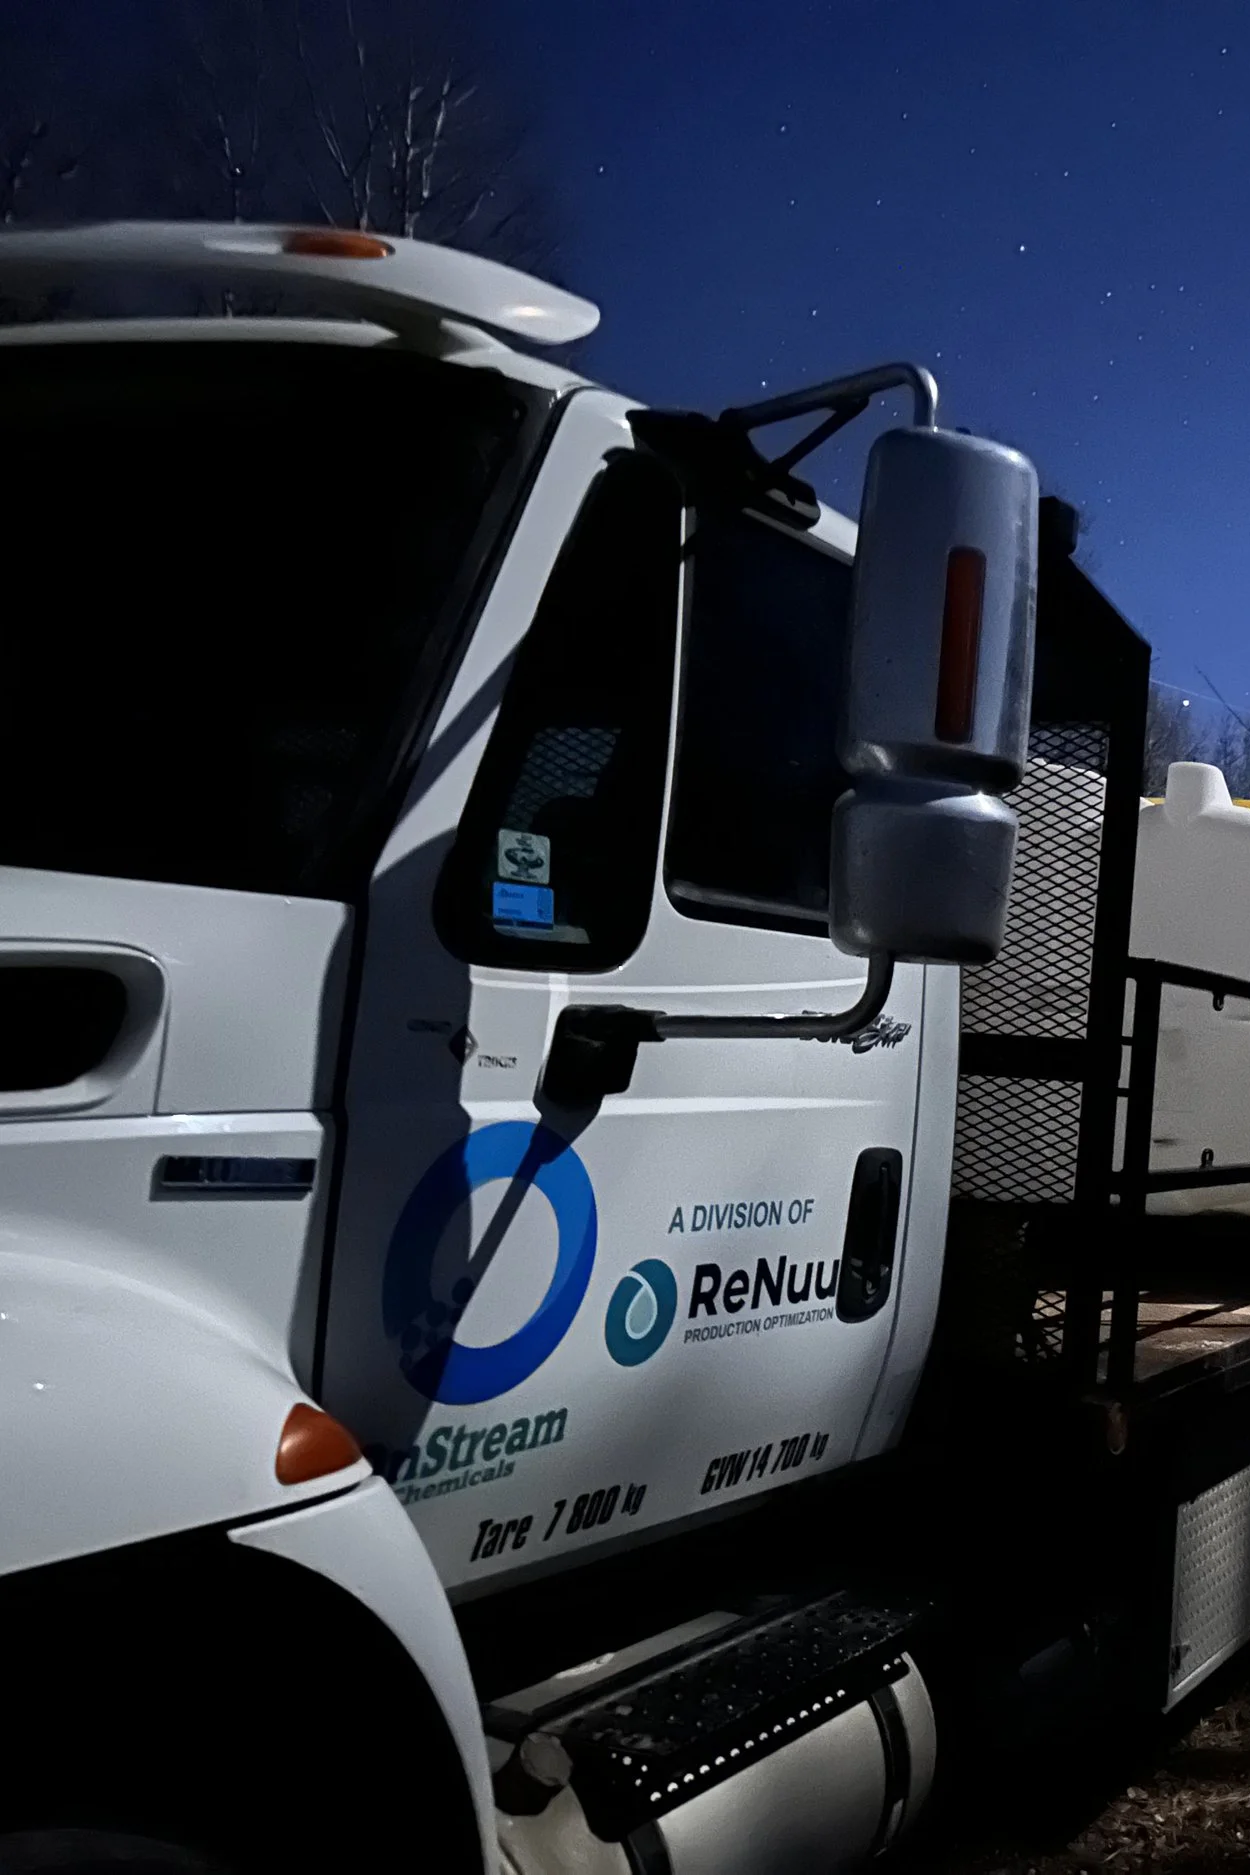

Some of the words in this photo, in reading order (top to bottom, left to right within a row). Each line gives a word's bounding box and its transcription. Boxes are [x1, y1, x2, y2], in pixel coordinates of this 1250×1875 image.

[668, 1206, 685, 1234] A
[691, 1200, 783, 1232] DIVISION
[788, 1199, 815, 1225] OF
[688, 1255, 840, 1319] ReNuu
[684, 1318, 761, 1344] PRODUCTION
[763, 1306, 834, 1331] OPTIMIZATION
[396, 1458, 515, 1505] hemicals
[701, 1450, 752, 1495] GVW
[745, 1443, 773, 1482] 14
[770, 1433, 811, 1475] 700
[809, 1431, 829, 1461] kg
[470, 1515, 533, 1563] Tare
[543, 1499, 567, 1542] 7
[566, 1485, 621, 1535] 800
[621, 1483, 648, 1516] kg
